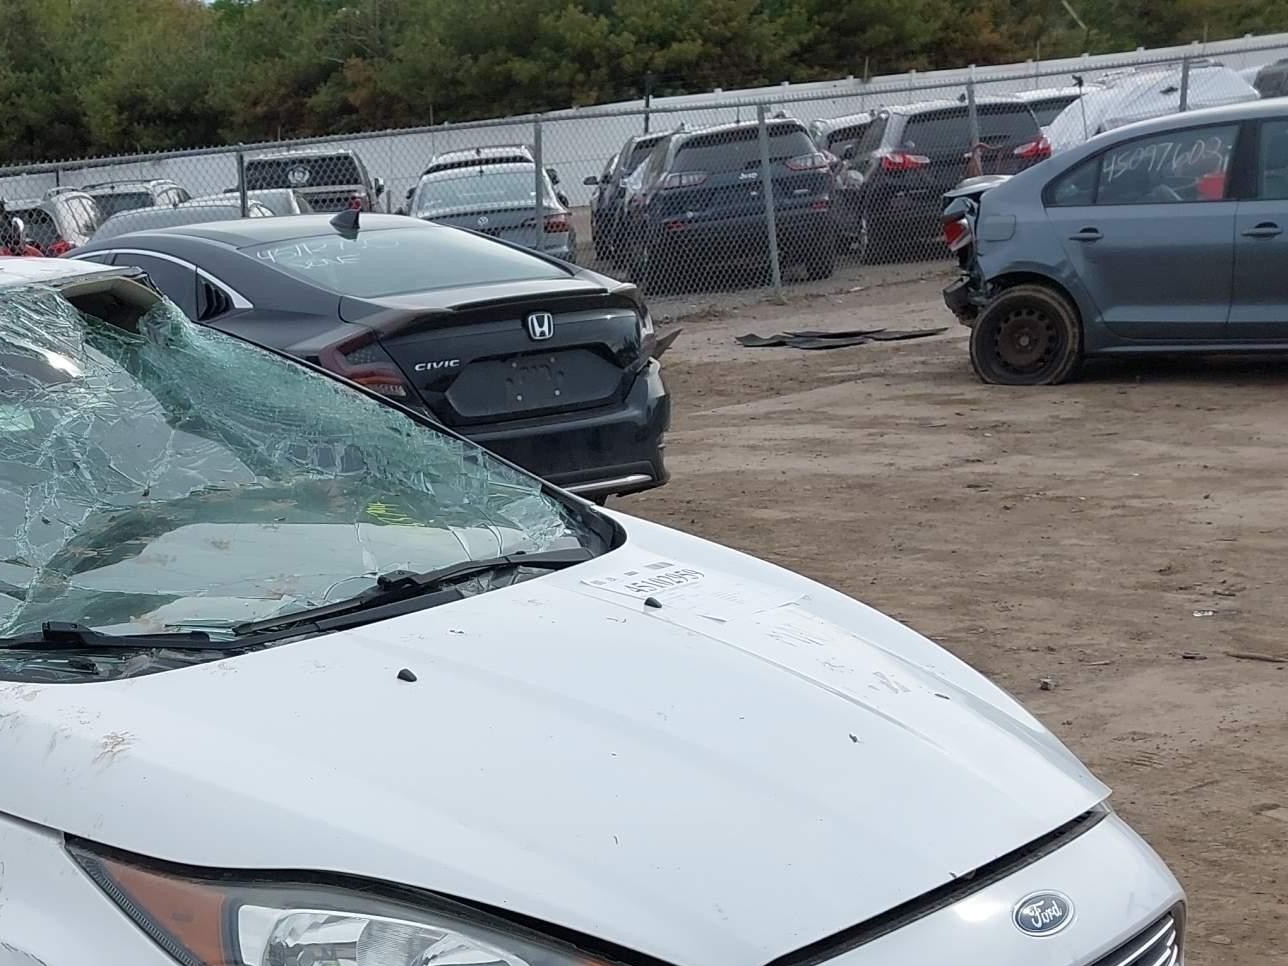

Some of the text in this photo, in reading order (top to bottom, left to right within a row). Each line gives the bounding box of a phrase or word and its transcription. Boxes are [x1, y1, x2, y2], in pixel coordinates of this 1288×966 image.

[1102, 136, 1223, 183] 45097603
[414, 359, 460, 371] CIVIC
[624, 568, 705, 594] 45102959
[1022, 900, 1062, 929] Ford
